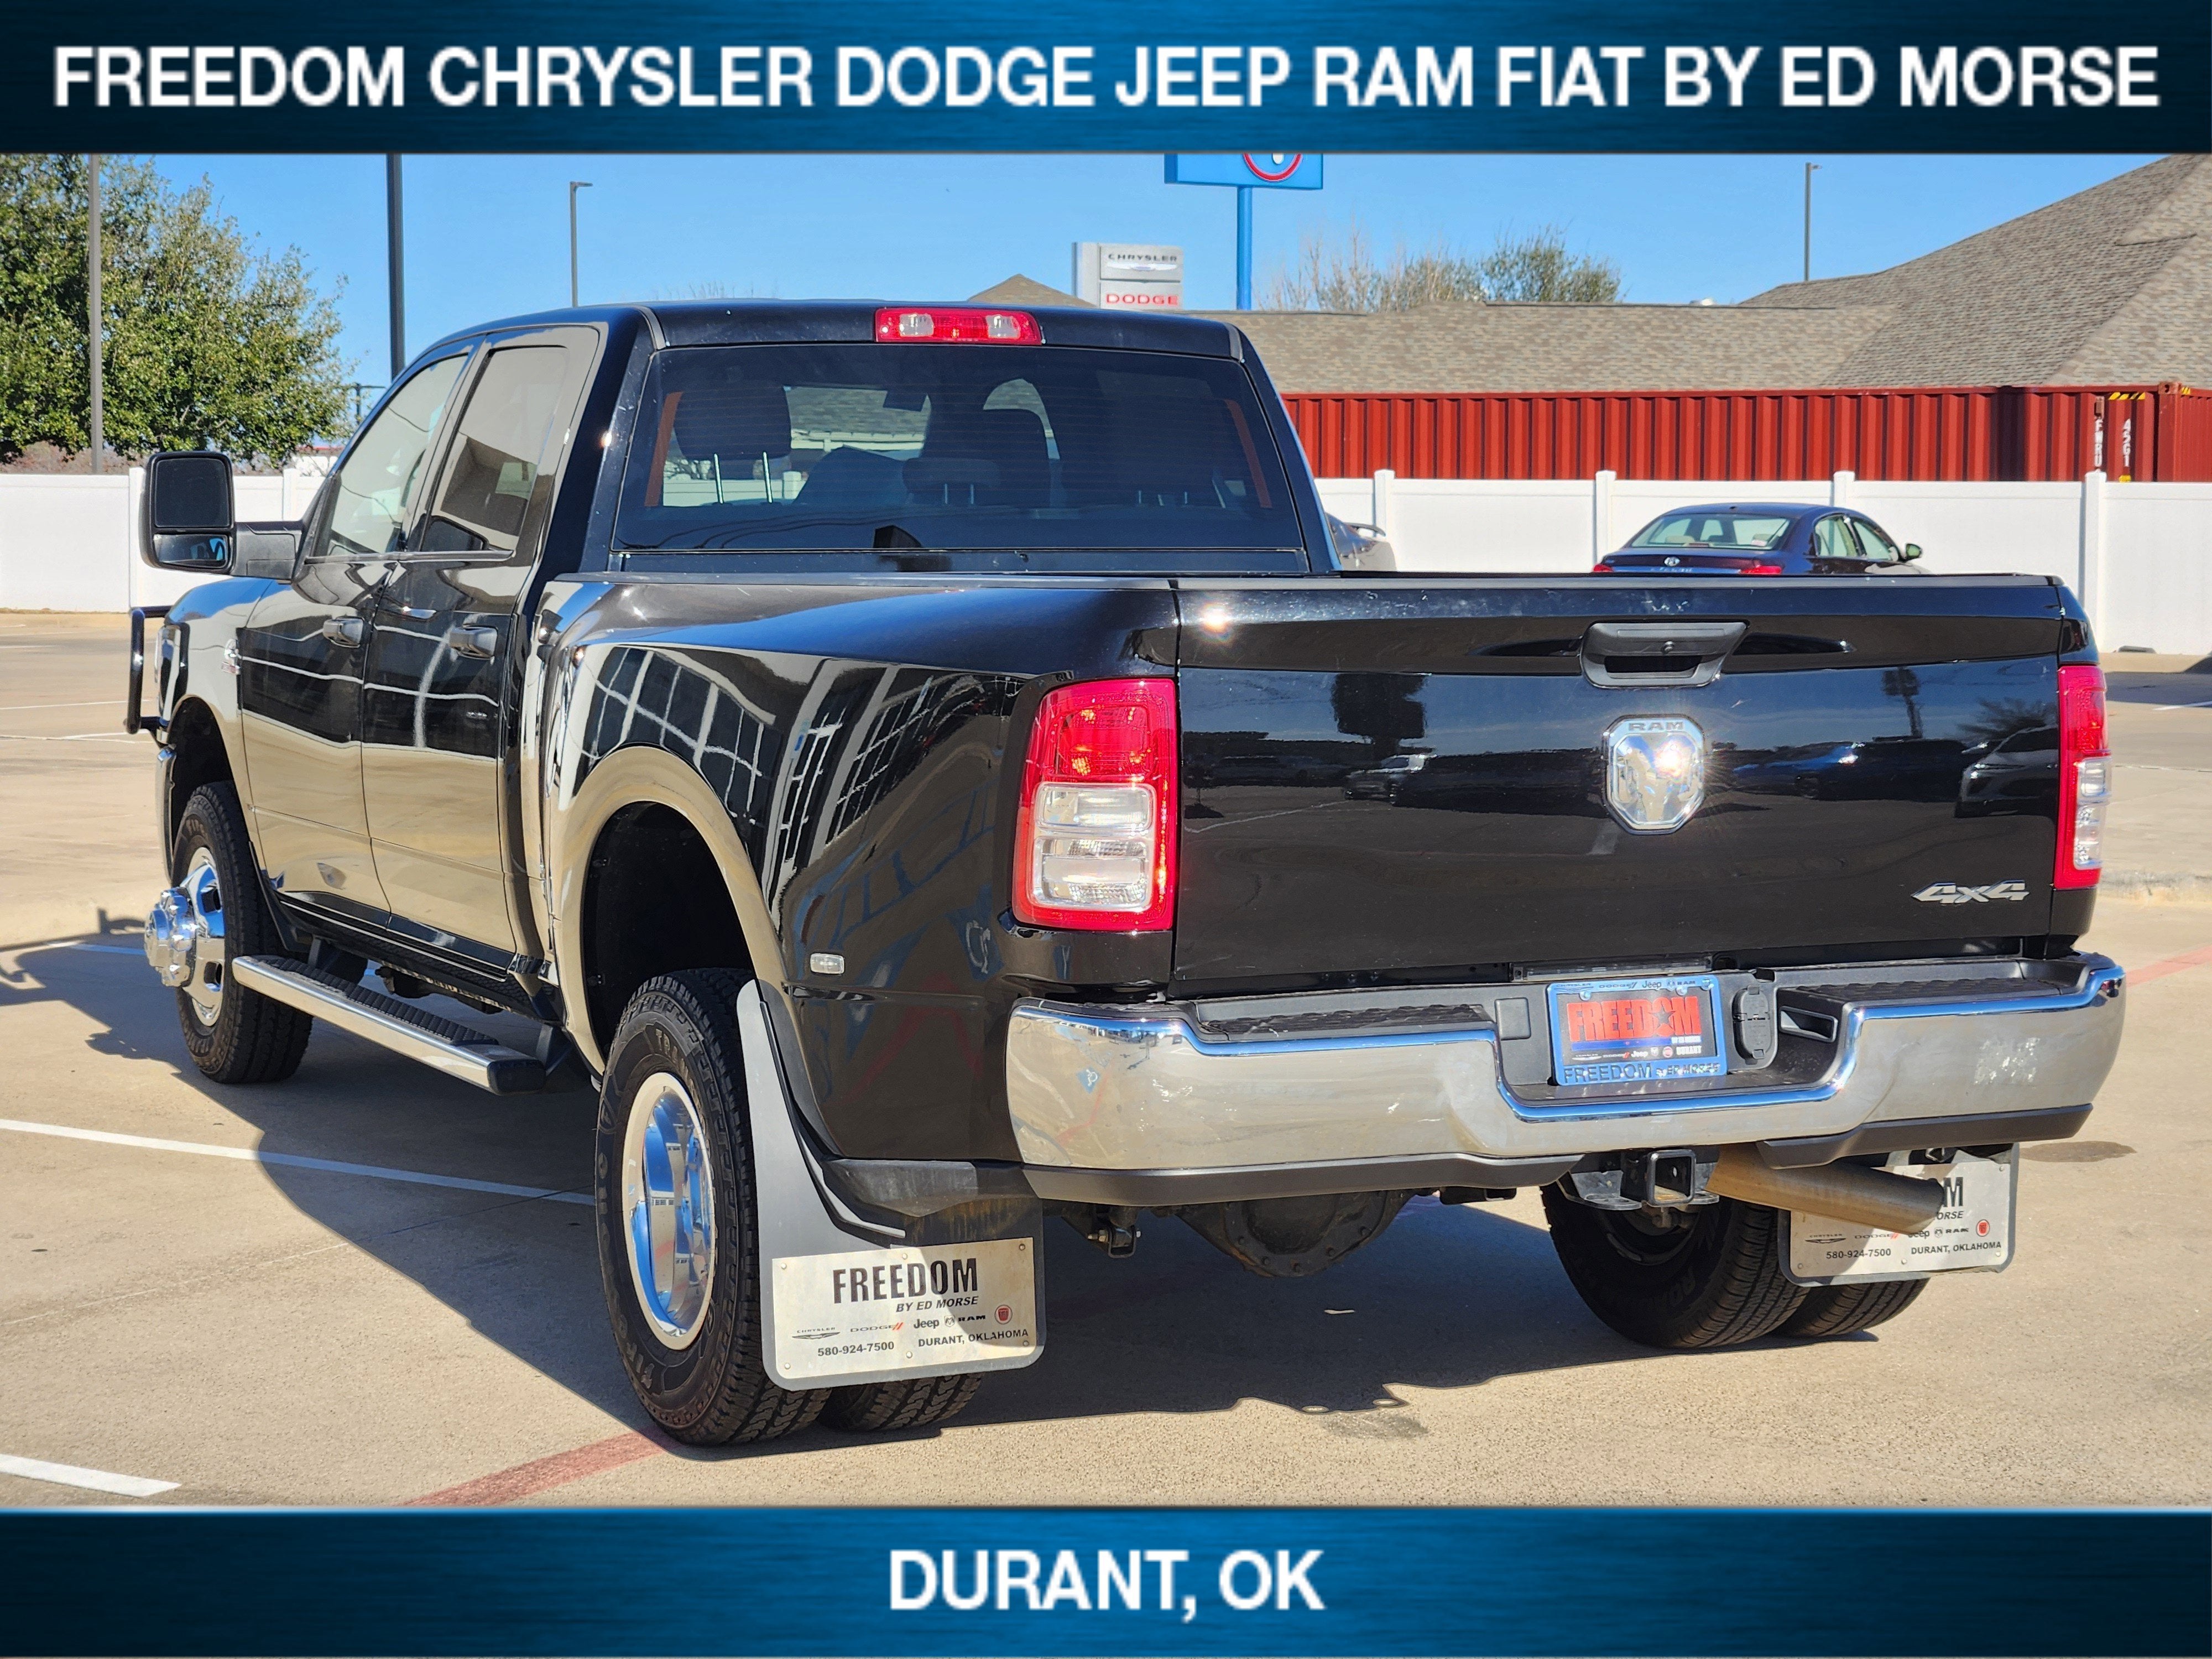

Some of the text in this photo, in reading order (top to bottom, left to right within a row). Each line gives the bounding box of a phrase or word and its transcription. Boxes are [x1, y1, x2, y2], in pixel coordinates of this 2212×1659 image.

[1108, 253, 1177, 262] CHRYSLER
[1106, 294, 1178, 306] DODGE
[1629, 721, 1684, 731] RAM
[1642, 980, 1661, 989] Jeep
[1566, 996, 1702, 1042] FREEDOM
[1563, 1062, 1652, 1084] FREEDOM
[1937, 1211, 1964, 1220] ORSE
[1826, 1241, 2001, 1259] 580-924-7500 DURANT, OKLAHOMA
[833, 1258, 978, 1304] FREEDOM
[896, 1296, 979, 1312] BY ED MORSE
[914, 1318, 940, 1329] Jeep
[818, 1329, 1029, 1357] 580-924-7500 DURANT, OKLAHOMA
